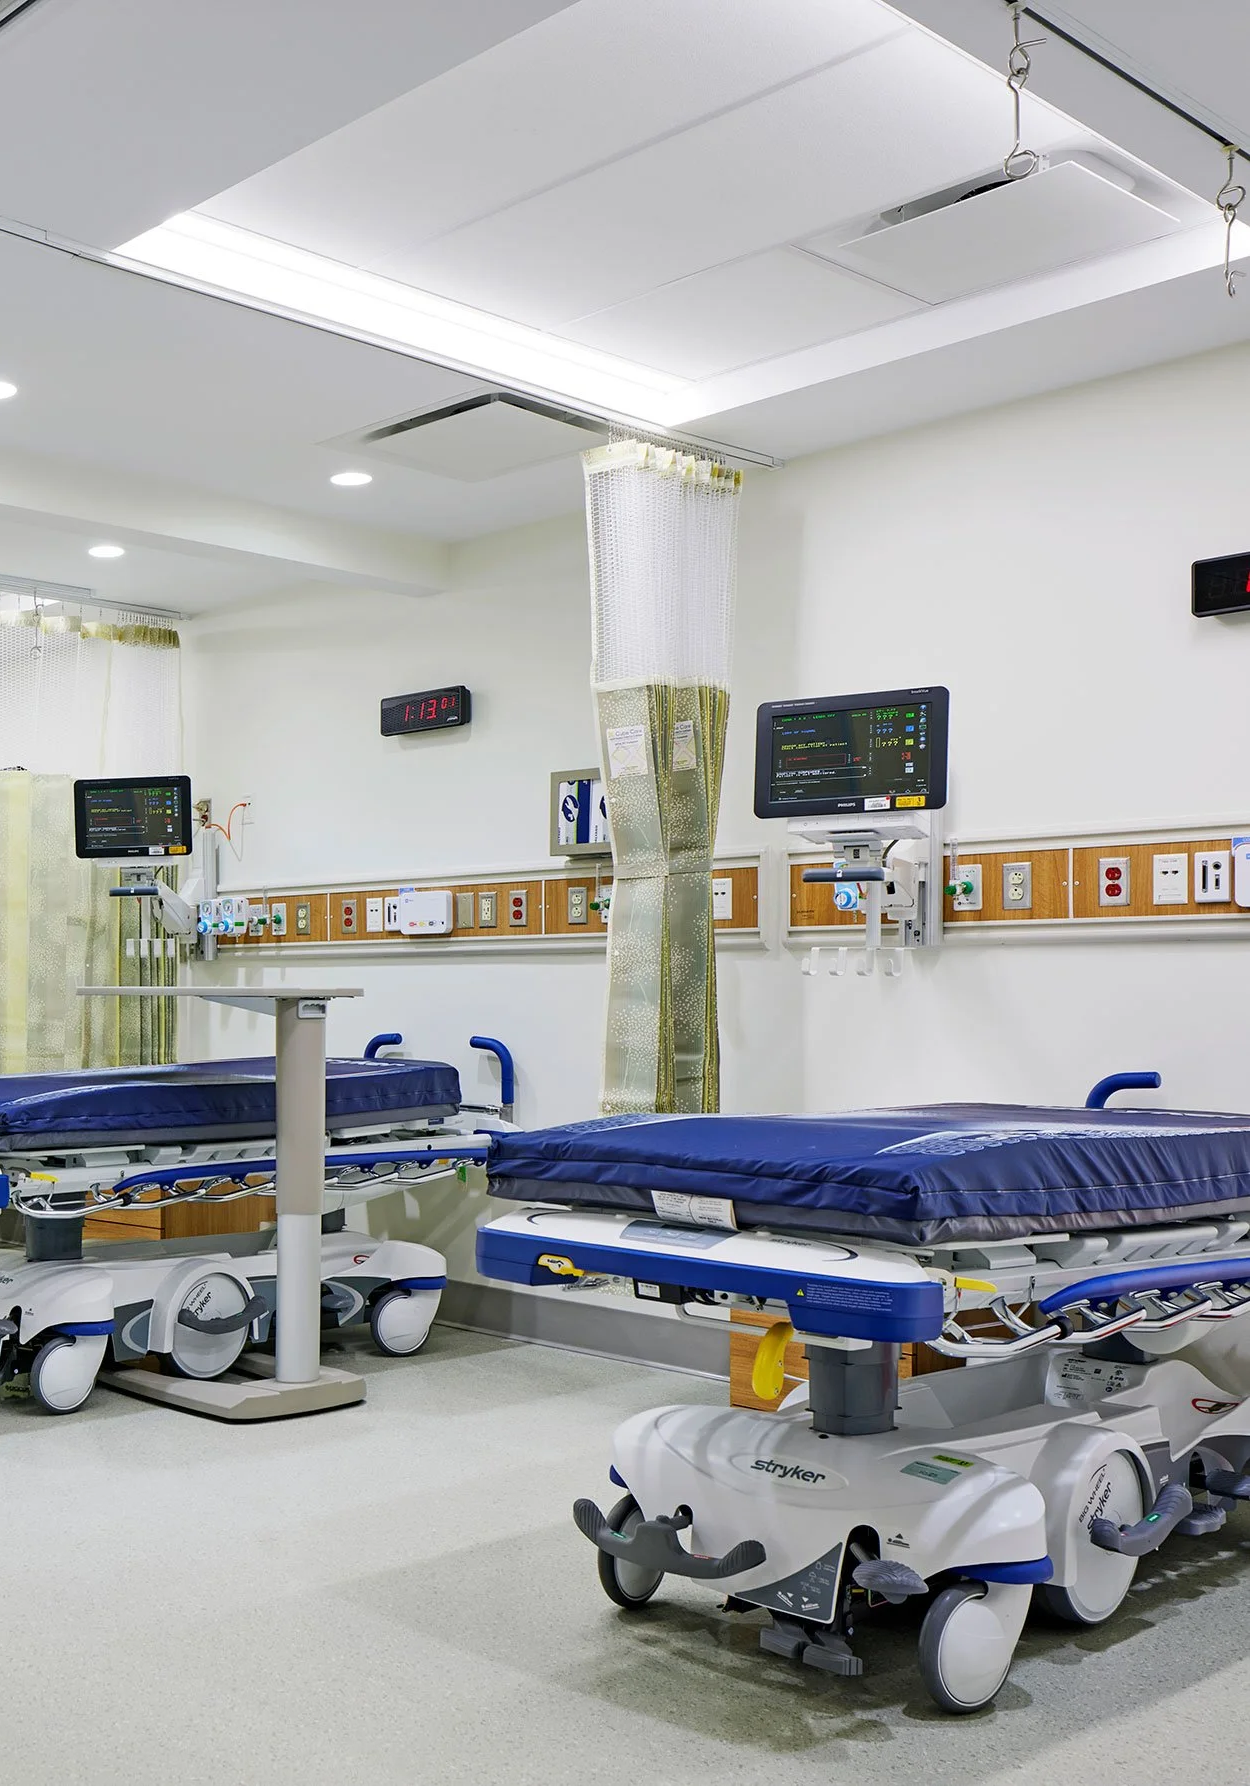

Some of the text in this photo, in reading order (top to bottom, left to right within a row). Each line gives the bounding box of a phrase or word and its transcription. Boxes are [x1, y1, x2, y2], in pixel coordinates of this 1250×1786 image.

[404, 698, 438, 722] 1:13
[192, 1291, 212, 1316] ryker
[750, 1459, 826, 1484] stryker
[1077, 1506, 1091, 1524] BIG
